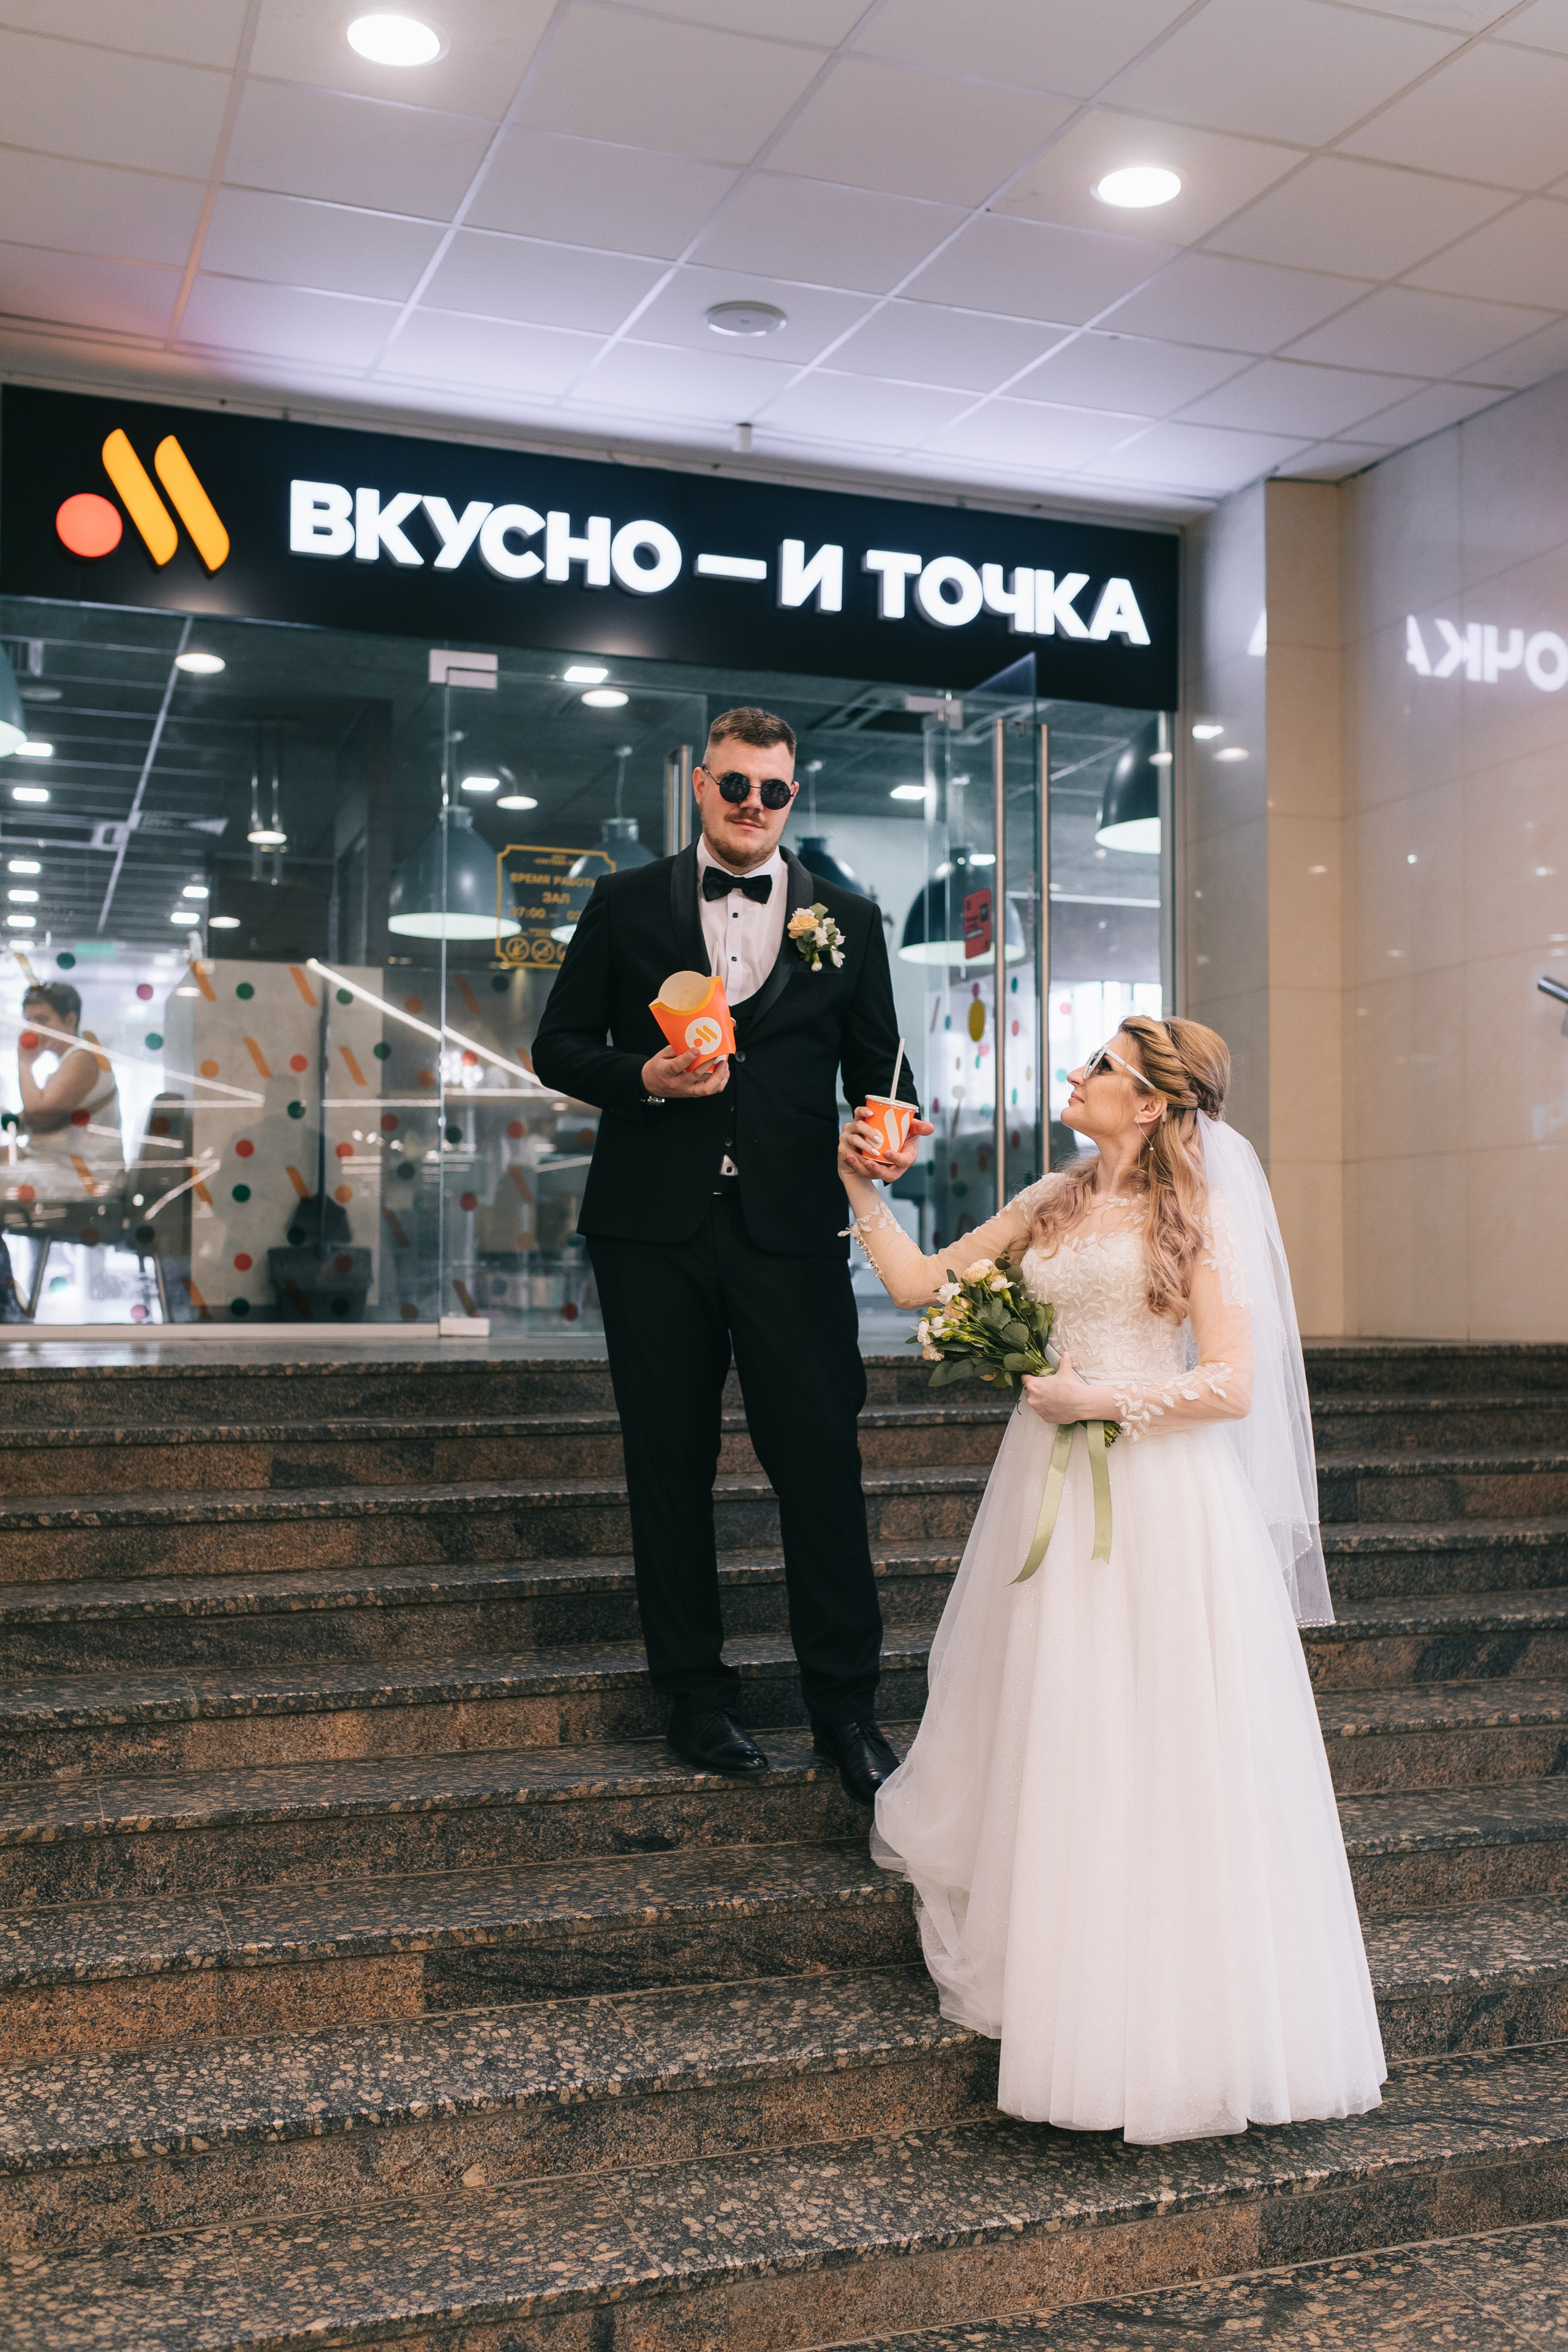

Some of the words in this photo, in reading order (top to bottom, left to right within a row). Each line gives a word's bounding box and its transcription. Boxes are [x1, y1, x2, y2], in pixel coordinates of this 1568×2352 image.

[290, 480, 682, 593] ВКУСНО
[782, 538, 843, 612] И
[866, 549, 1151, 645] ТОЧКА
[510, 872, 551, 884] ВРЕМЯ
[542, 891, 570, 904] ЗАЛ
